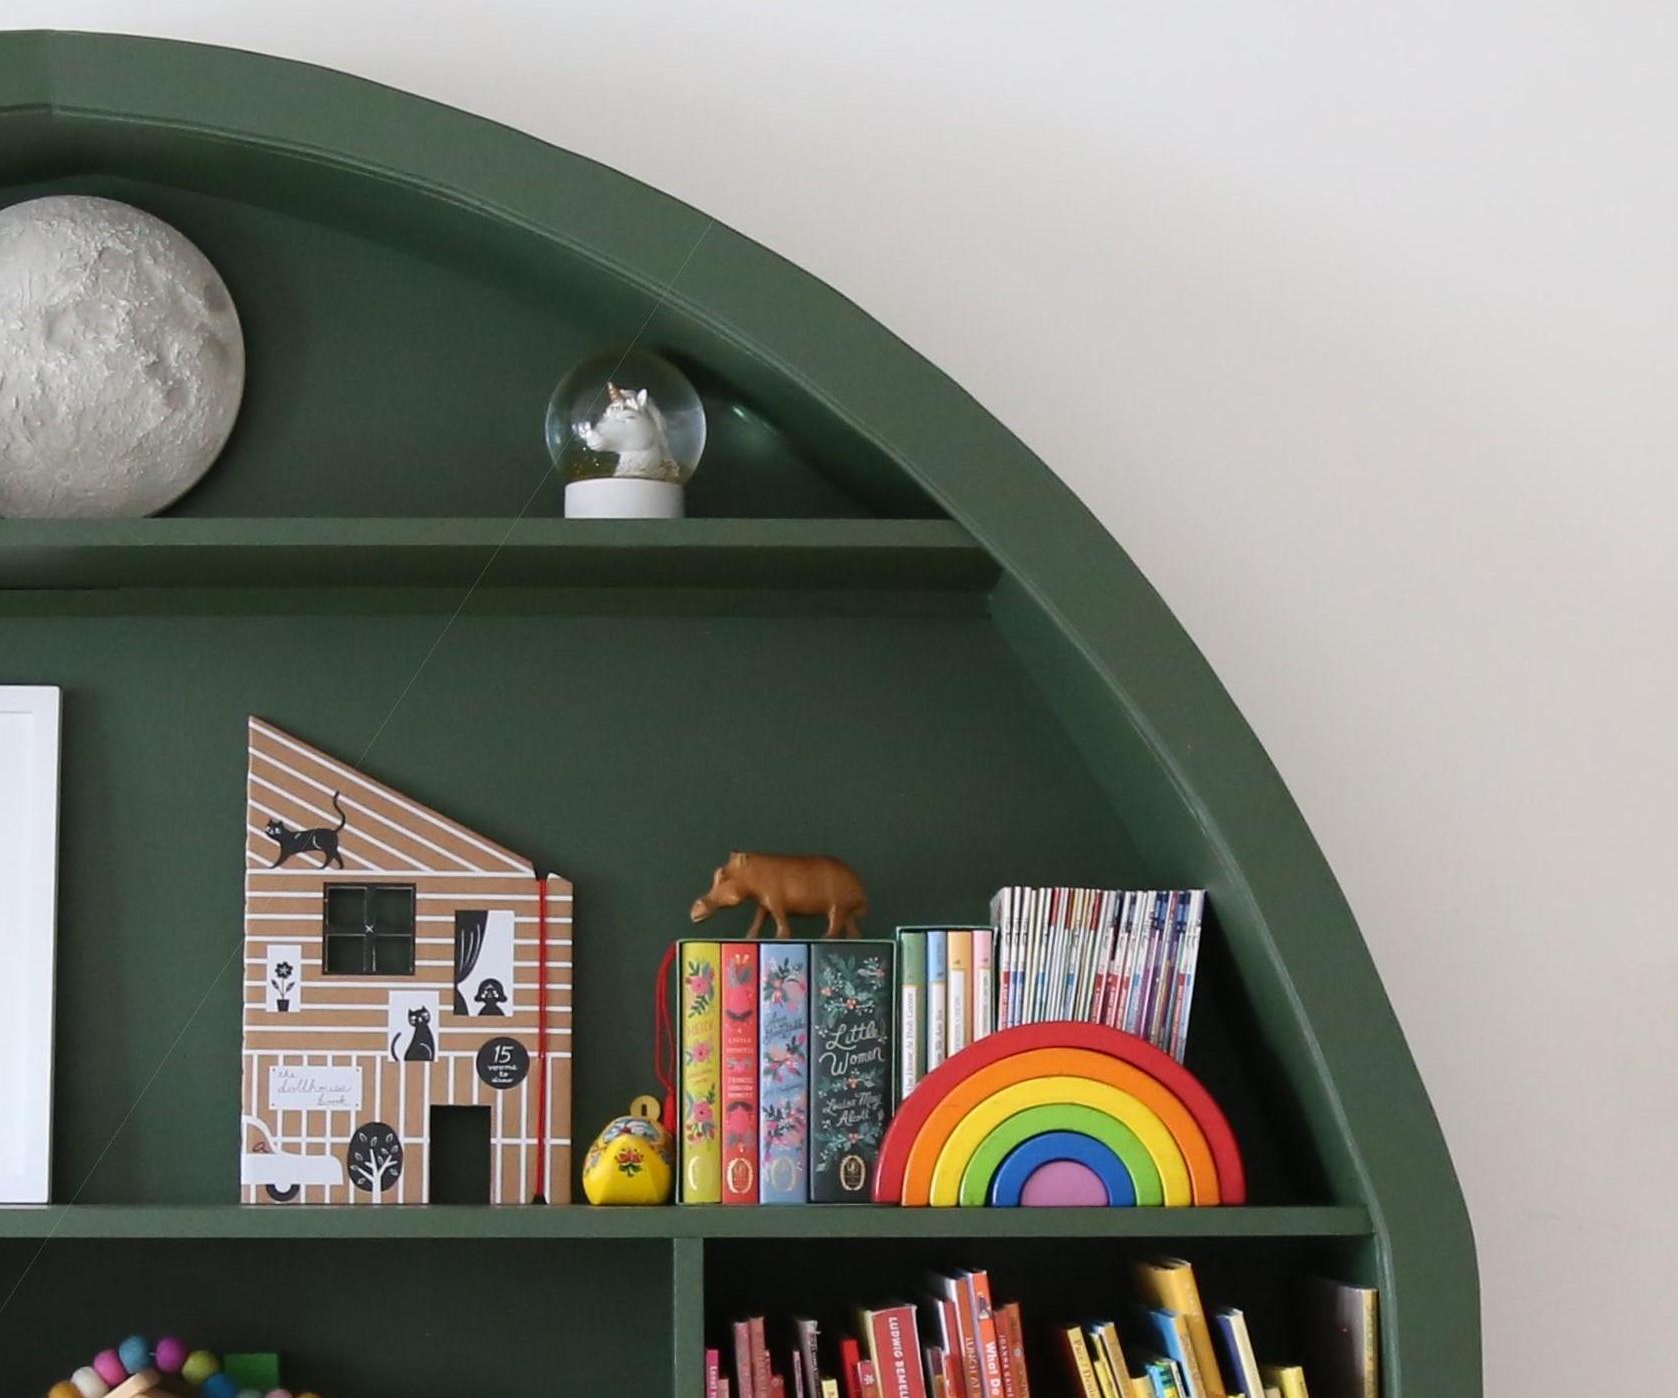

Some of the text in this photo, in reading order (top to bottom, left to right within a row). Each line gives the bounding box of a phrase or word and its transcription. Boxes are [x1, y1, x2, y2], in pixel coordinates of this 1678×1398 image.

[826, 1020, 878, 1051] Little
[494, 1045, 515, 1064] 15
[818, 1046, 884, 1076] Women
[887, 1315, 904, 1359] LUDWIG
[997, 1334, 1010, 1369] JOANNA
[964, 1336, 977, 1373] LUNCH
[983, 1341, 998, 1374] What
